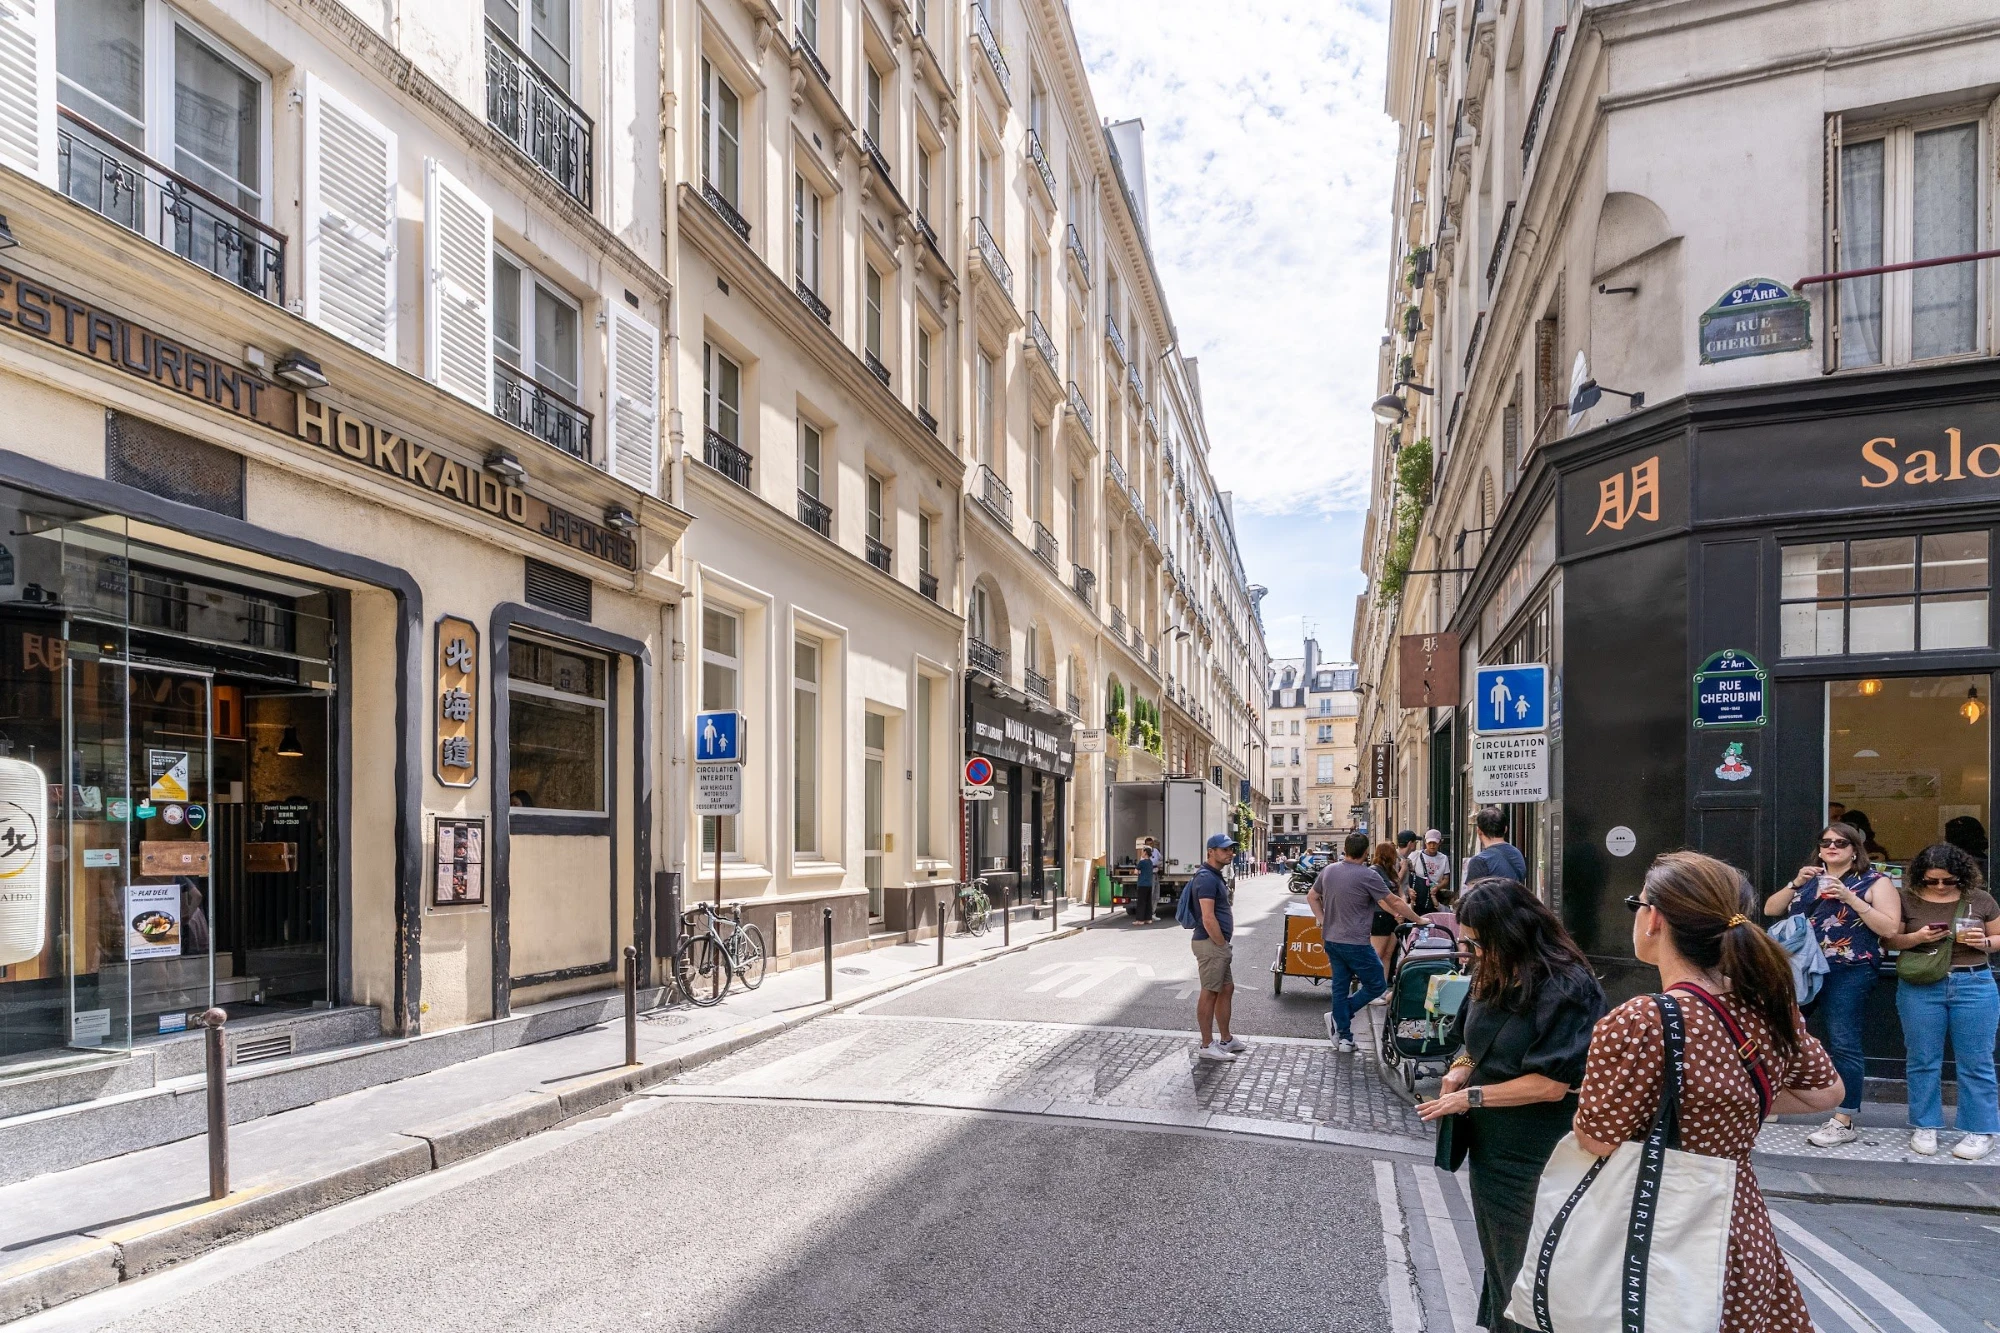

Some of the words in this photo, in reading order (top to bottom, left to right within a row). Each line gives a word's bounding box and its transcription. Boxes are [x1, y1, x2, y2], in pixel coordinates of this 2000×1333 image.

[1735, 317, 1771, 332] RUE
[1706, 332, 1801, 353] CHERUBI
[296, 393, 528, 526] HOKKAIDO
[541, 506, 631, 567] JAPONAIS
[1586, 455, 1660, 535] 朋
[1719, 680, 1741, 691] RUE
[443, 637, 473, 769] 北海道
[1700, 691, 1761, 704] CHERUBINI
[1004, 717, 1033, 746] NOUILLE
[1033, 729, 1059, 755] VIVANTE
[1475, 738, 1545, 750] CIRCULATION
[1482, 749, 1537, 760] INTERDITE
[1376, 747, 1385, 797] MASSAGE
[1483, 763, 1496, 772] AUX
[1498, 763, 1536, 771] VEHICULES
[1490, 771, 1529, 780] MOTORISES
[1477, 788, 1511, 797] DESSERTE
[1512, 788, 1542, 796] INTERNE
[1500, 780, 1518, 788] SAUF
[1633, 1179, 1654, 1242] FAIRLY
[1538, 1229, 1557, 1287] FAIRLY
[1561, 1175, 1592, 1219] JIMMY
[1627, 1255, 1642, 1317] JIMMY
